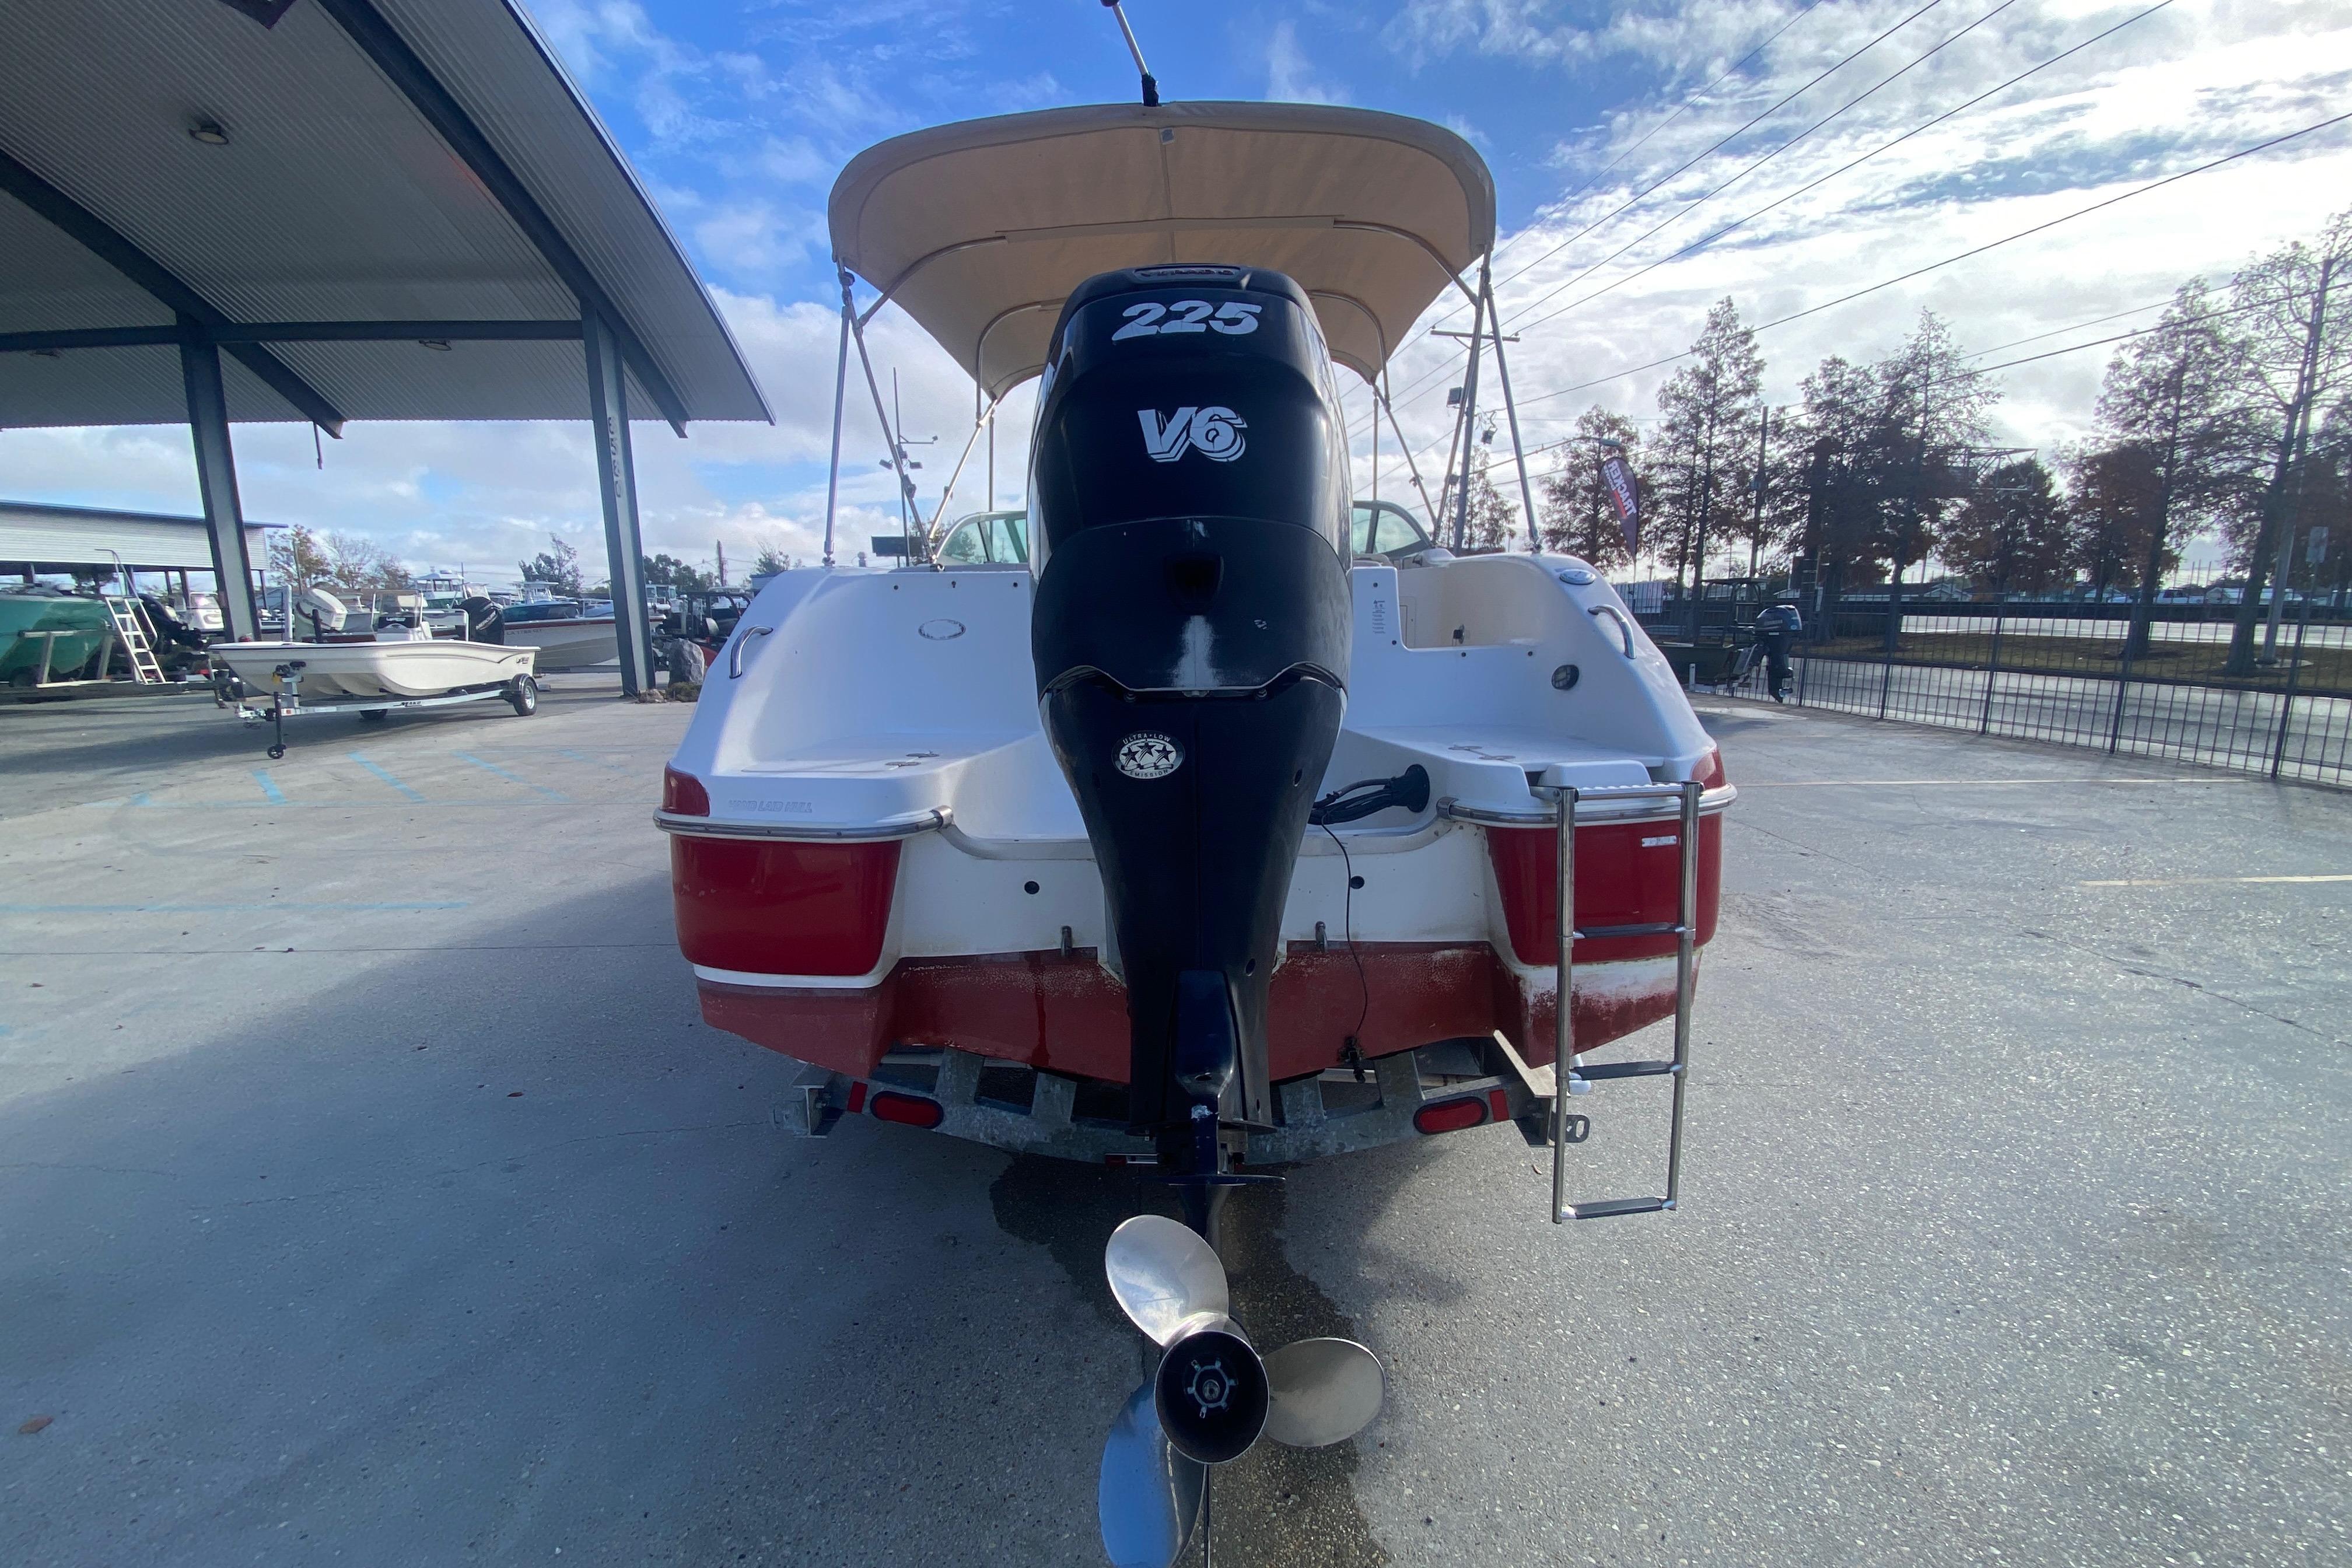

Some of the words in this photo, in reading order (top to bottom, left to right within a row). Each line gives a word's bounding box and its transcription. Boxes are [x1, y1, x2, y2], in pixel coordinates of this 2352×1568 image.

[1112, 300, 1262, 341] 225
[1138, 406, 1248, 463] V6
[1130, 769, 1168, 778] EMISSION
